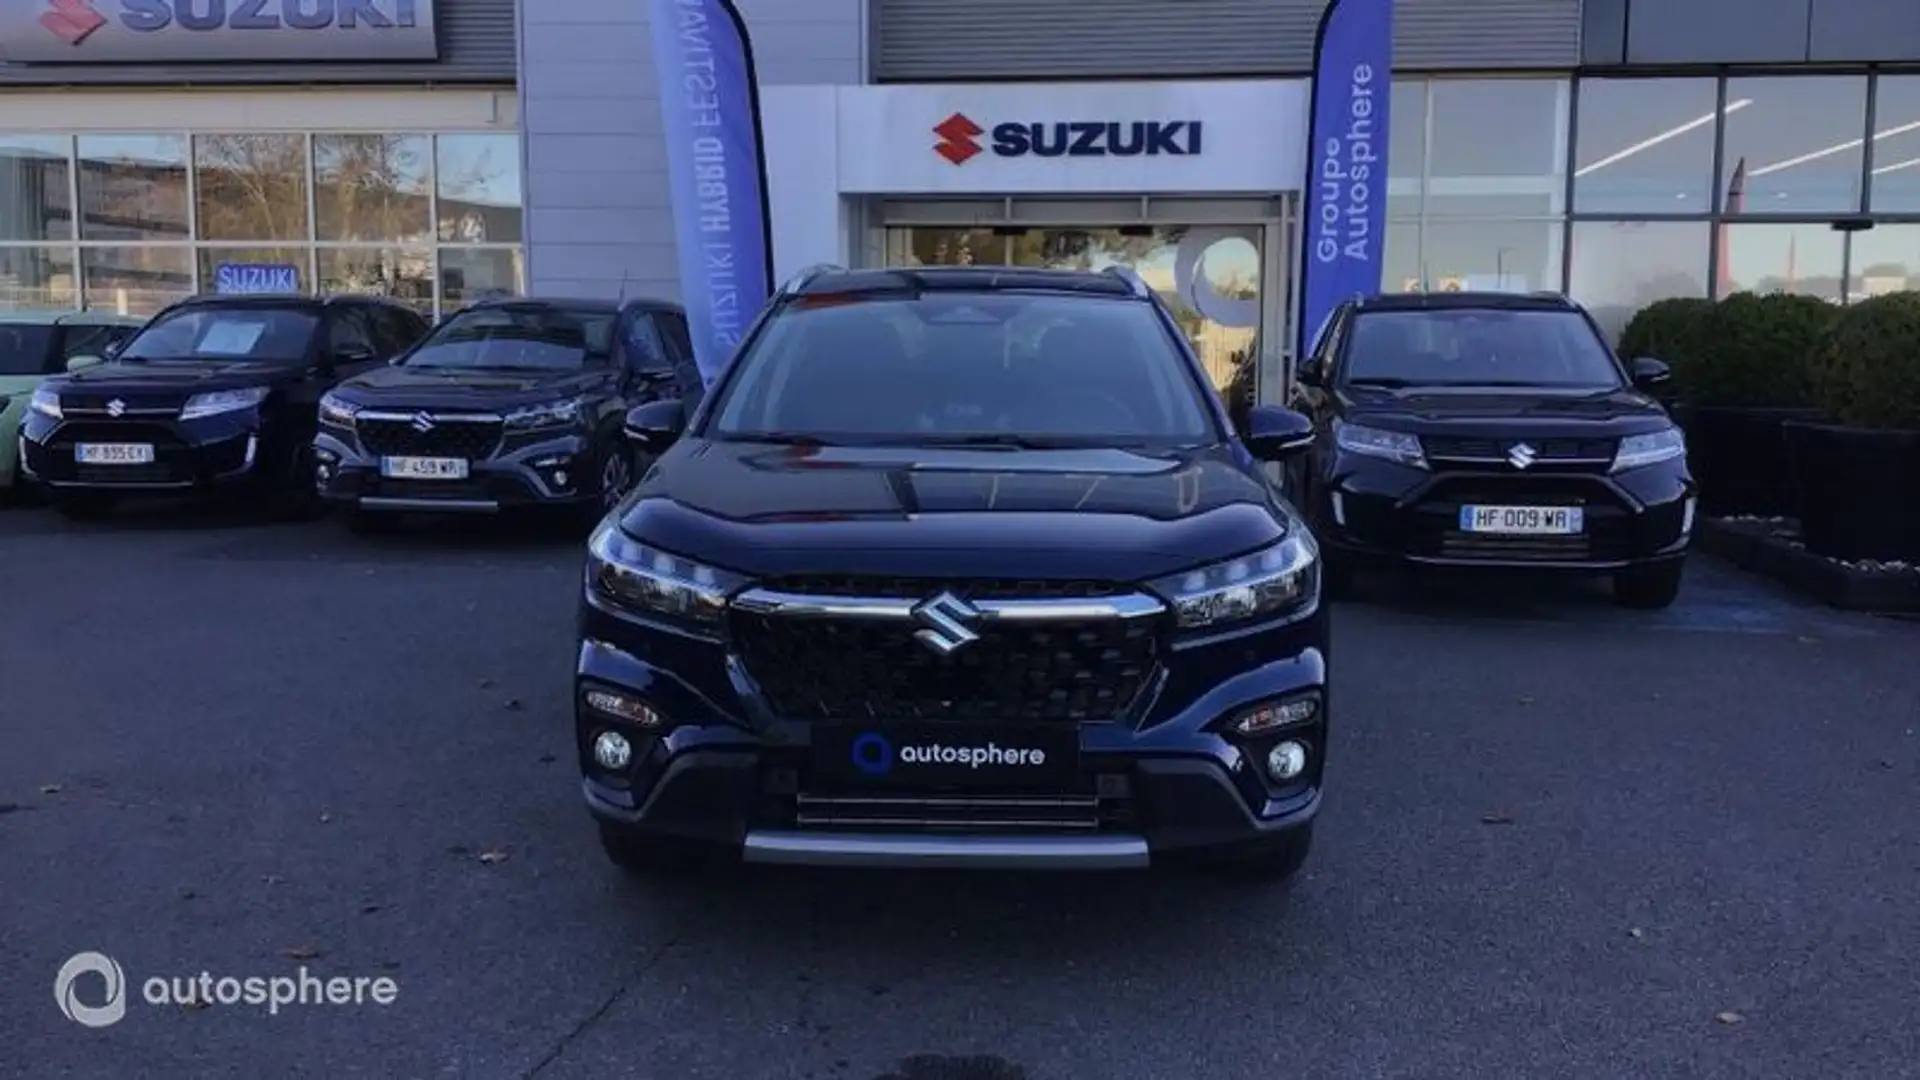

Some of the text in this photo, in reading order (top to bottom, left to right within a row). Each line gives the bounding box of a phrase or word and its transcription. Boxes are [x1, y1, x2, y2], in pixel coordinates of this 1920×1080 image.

[118, 0, 416, 31] SUZUKI
[991, 120, 1203, 157] SUZUKI
[1344, 63, 1377, 260] Autosphere
[1317, 136, 1347, 263] Groupe
[219, 265, 296, 290] SUZUKI
[900, 741, 1046, 769] autosphere
